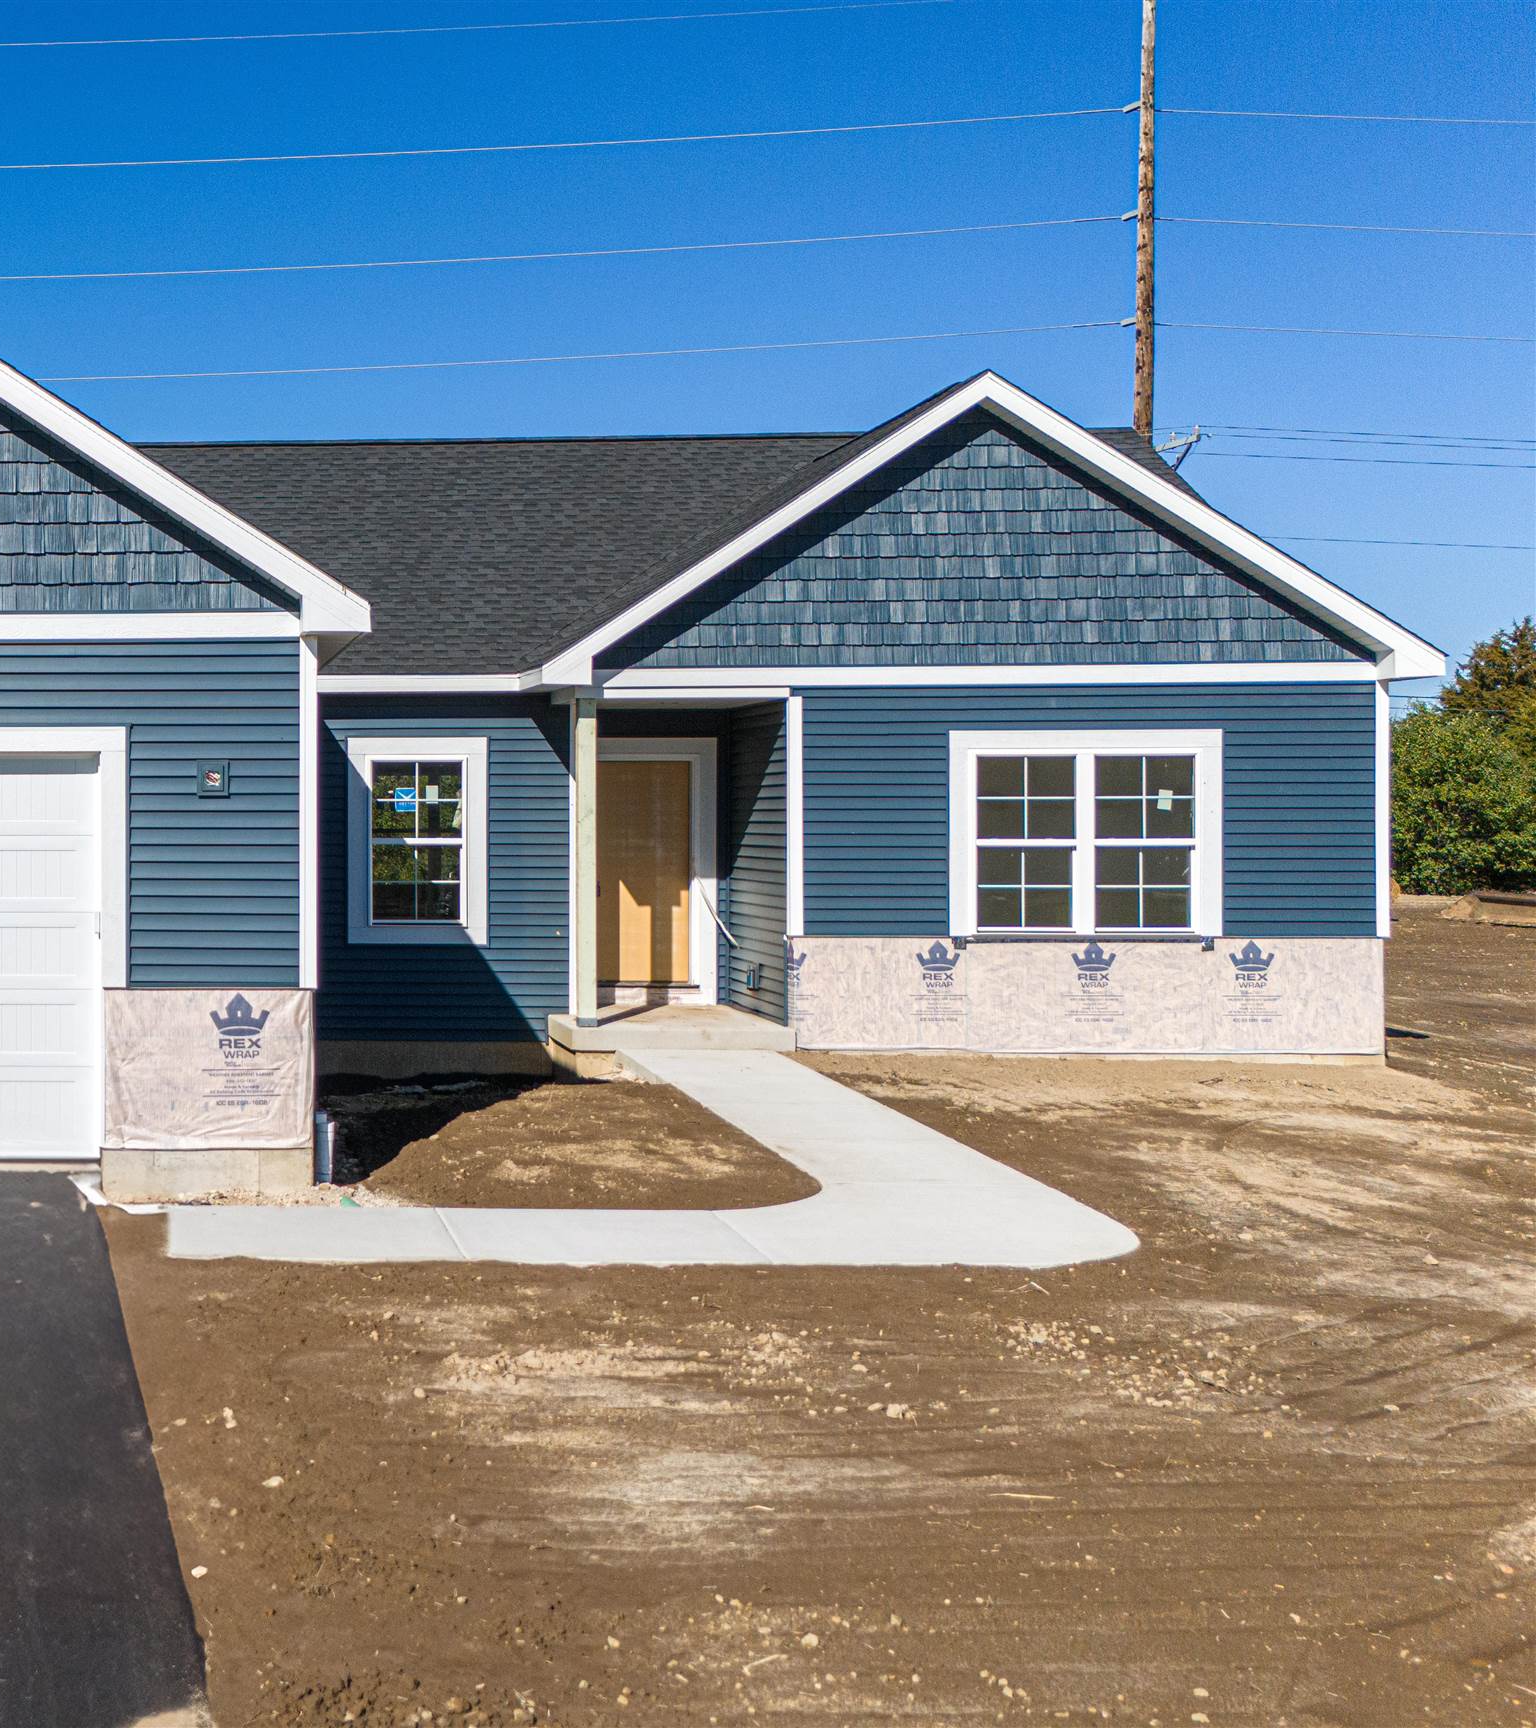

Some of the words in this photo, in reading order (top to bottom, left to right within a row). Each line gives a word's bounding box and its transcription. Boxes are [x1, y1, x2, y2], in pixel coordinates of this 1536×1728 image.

[922, 973, 954, 981] REX
[1077, 973, 1110, 981] REX
[1235, 973, 1268, 981] REX
[219, 1038, 261, 1049] REX
[223, 1050, 260, 1059] WRAP
